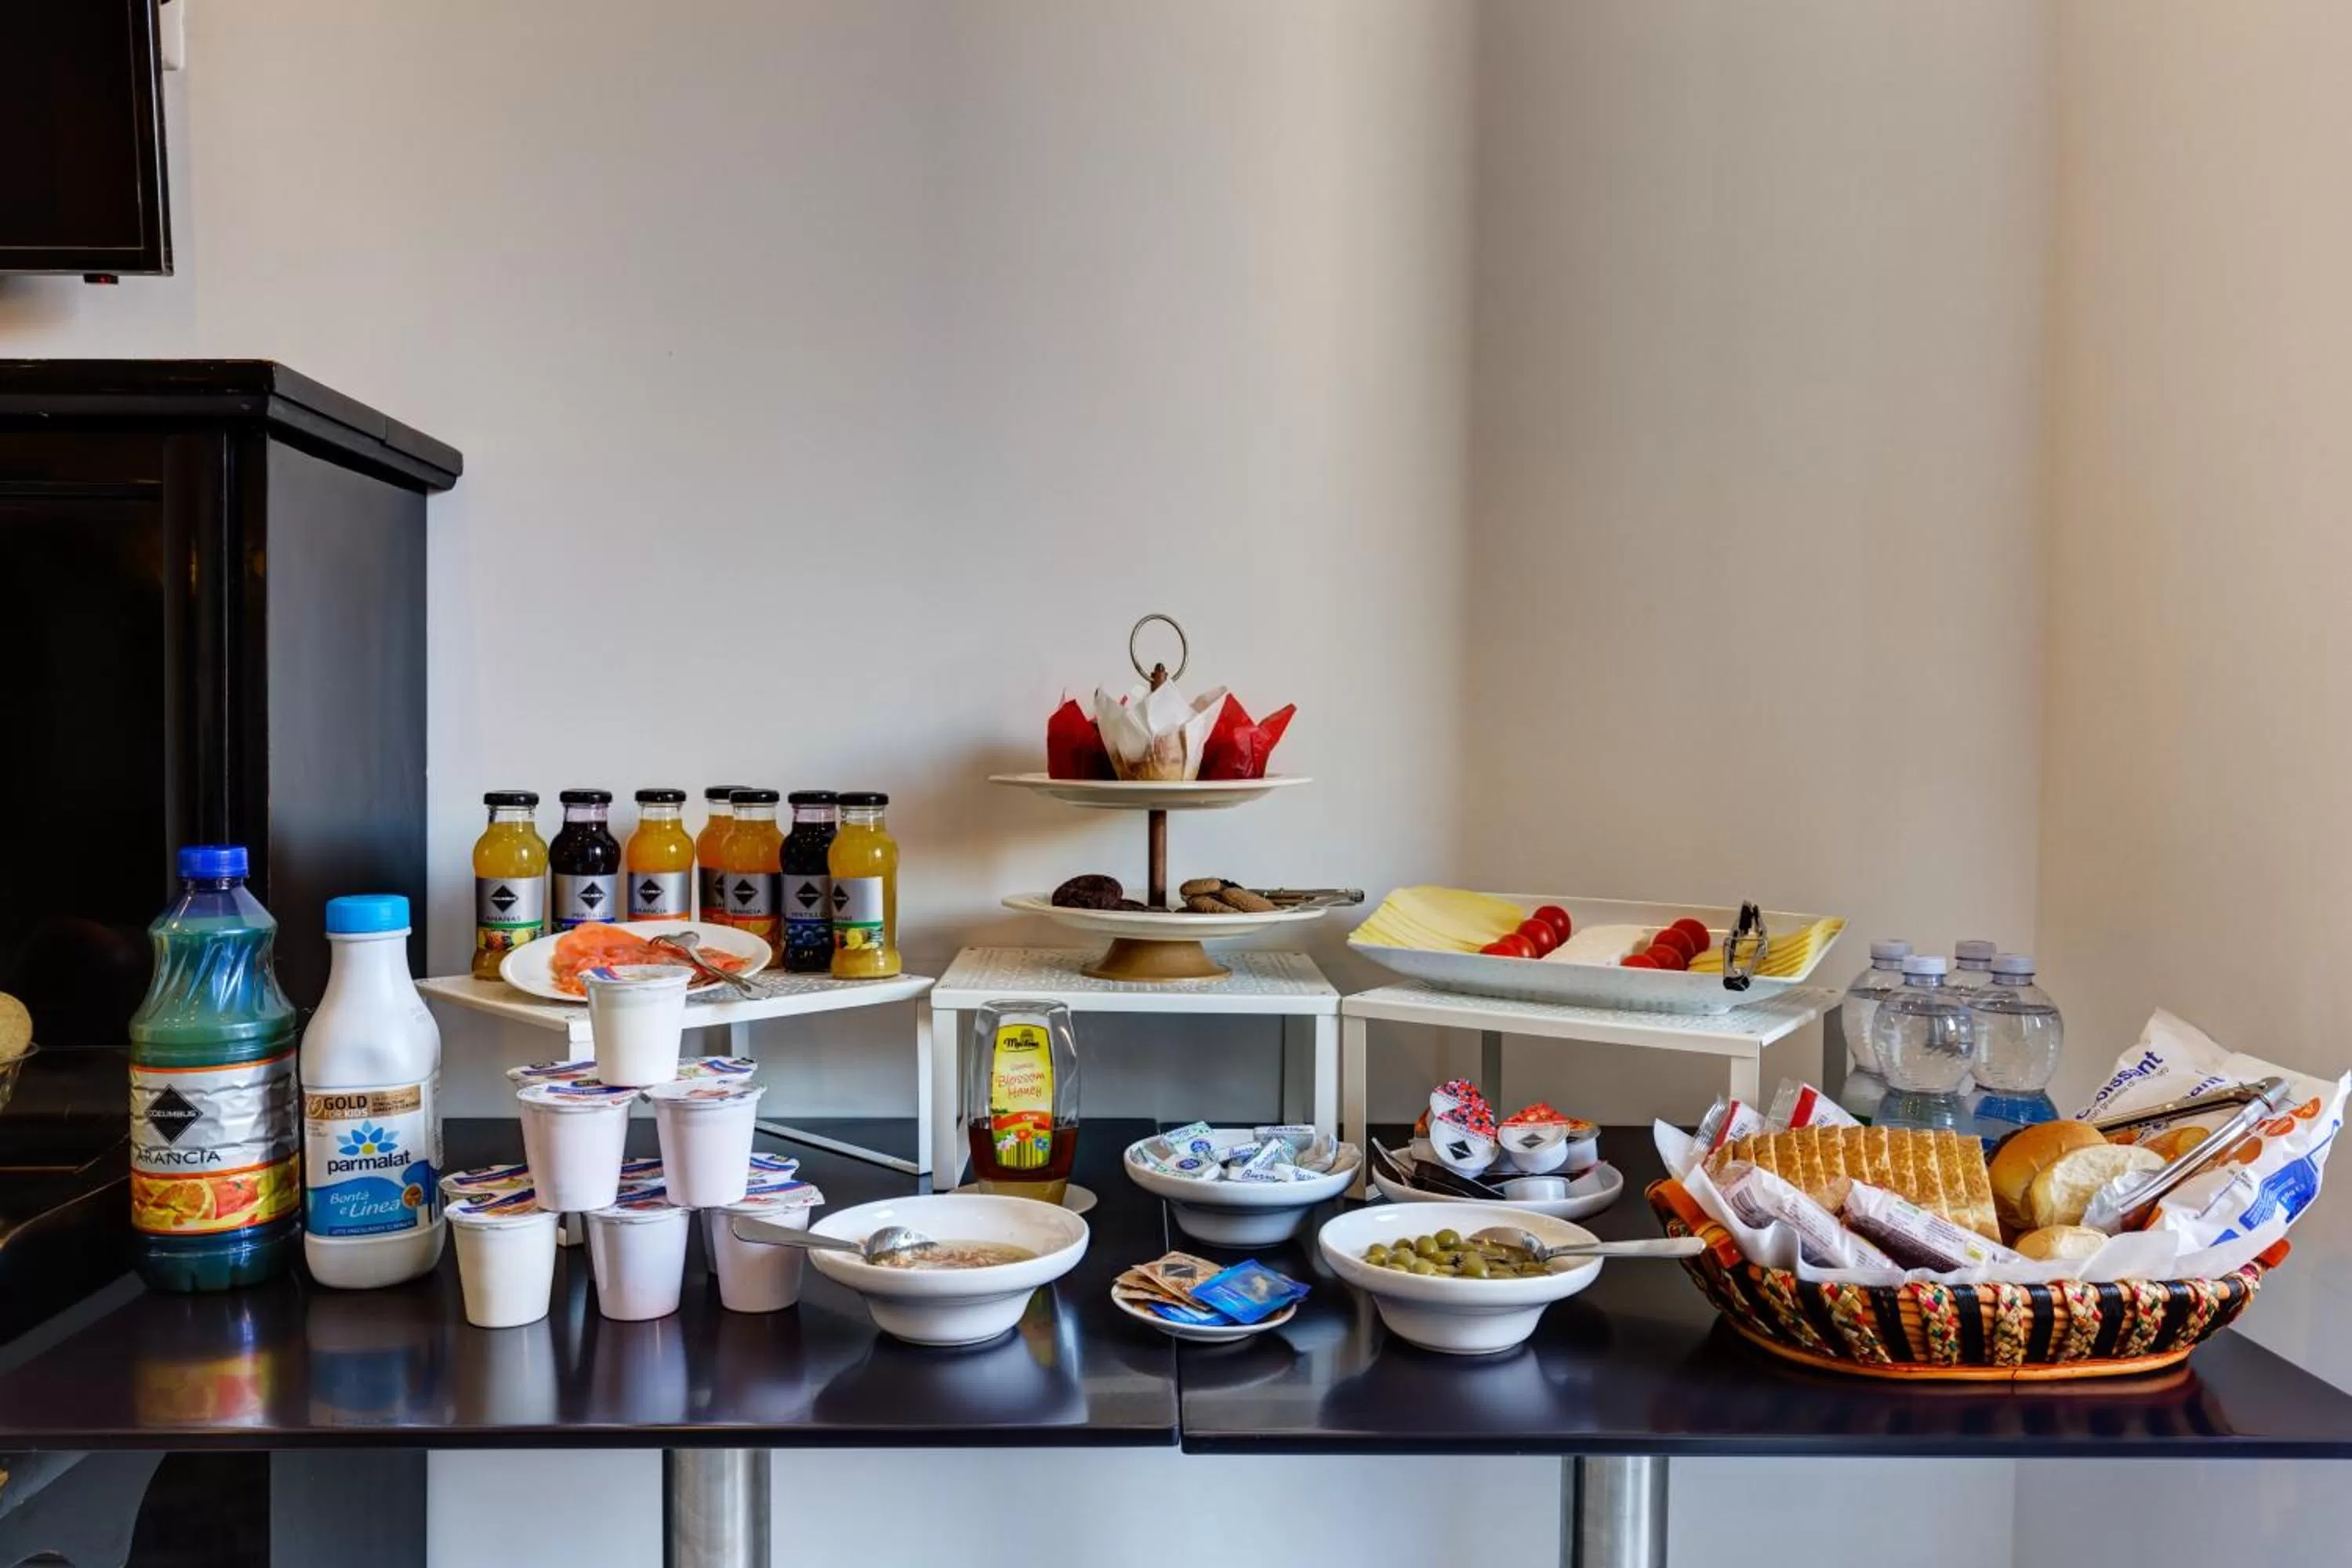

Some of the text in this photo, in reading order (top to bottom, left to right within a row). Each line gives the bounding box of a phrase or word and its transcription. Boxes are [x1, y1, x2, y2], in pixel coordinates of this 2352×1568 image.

[324, 1095, 367, 1110] GOLD
[324, 1107, 368, 1118] FOR KIDS
[327, 1149, 412, 1176] parmalat
[349, 1198, 401, 1218] Linea
